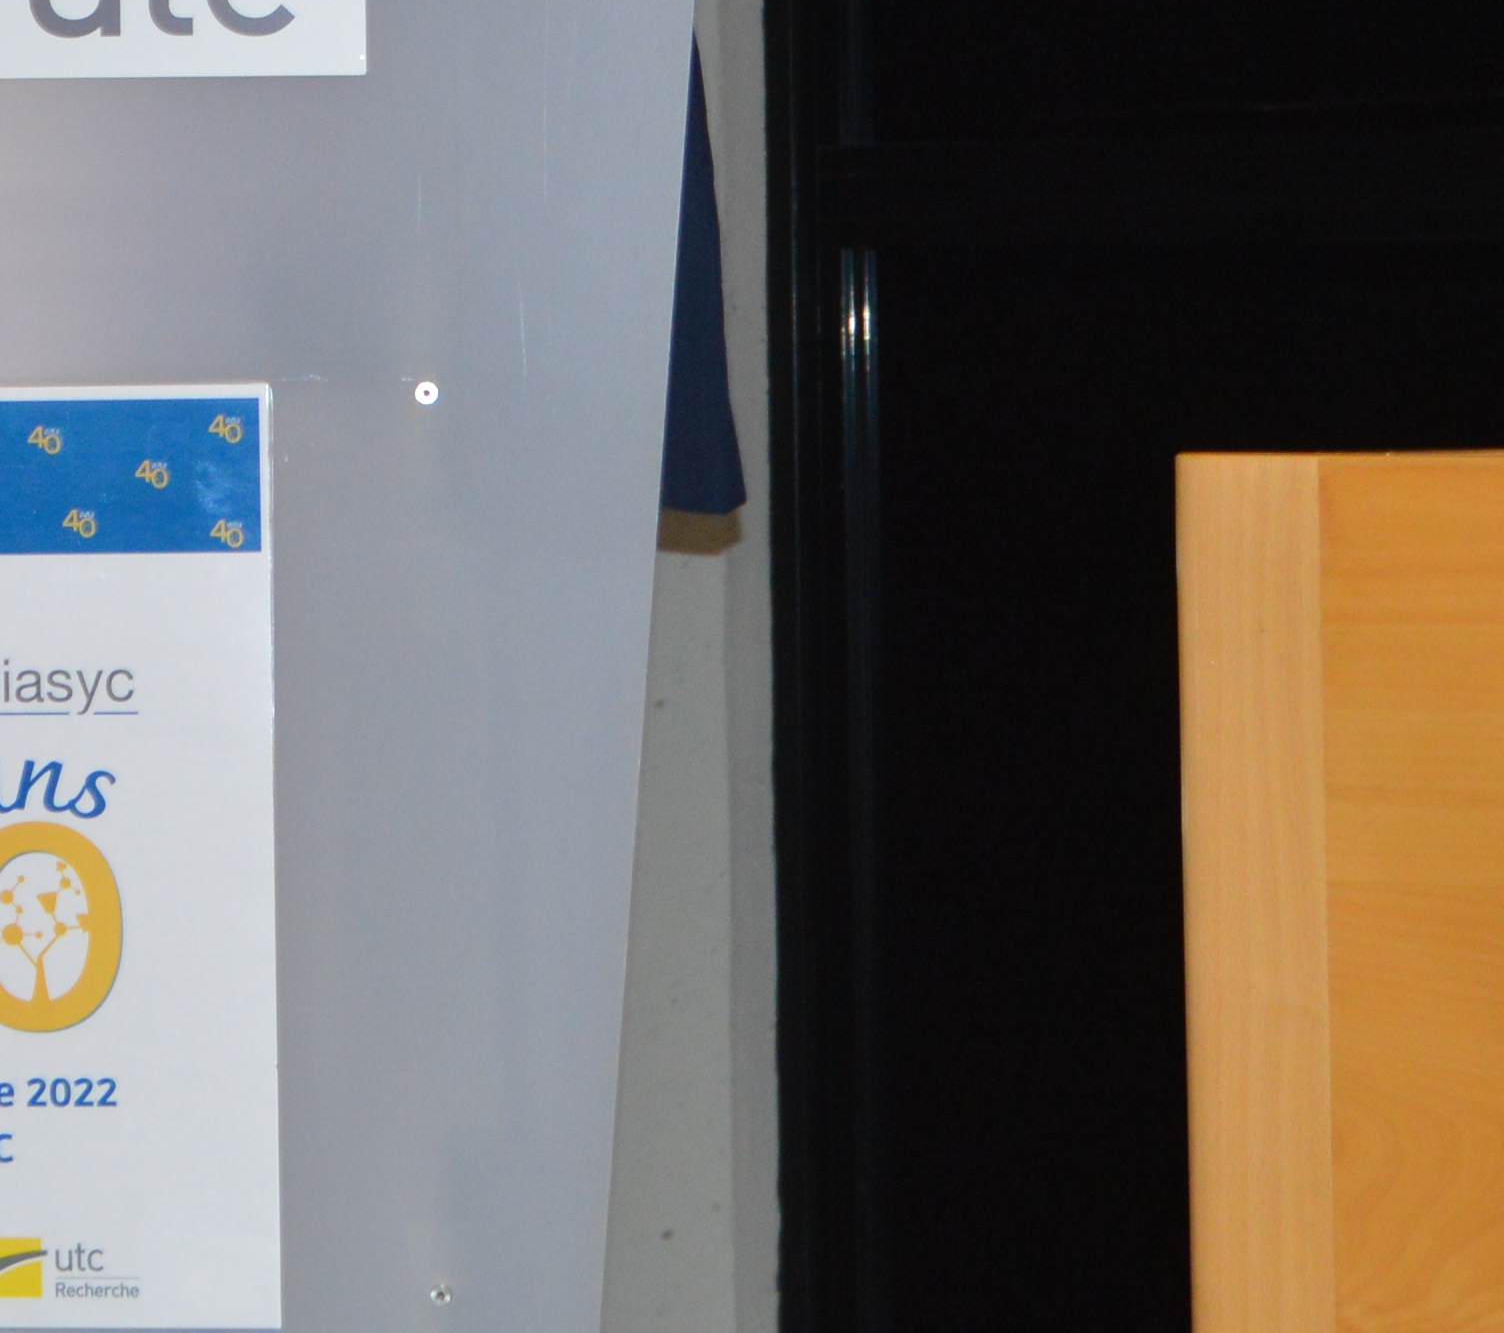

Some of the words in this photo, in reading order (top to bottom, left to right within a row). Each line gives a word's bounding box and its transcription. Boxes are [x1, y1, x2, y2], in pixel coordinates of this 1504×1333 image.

[28, 426, 62, 455] 40
[208, 414, 242, 444] 40
[135, 459, 169, 489] 40
[62, 509, 96, 538] 40
[210, 519, 244, 549] 40
[26, 1077, 118, 1108] 2022
[55, 1242, 104, 1272] utc
[55, 1282, 140, 1299] Recherche
